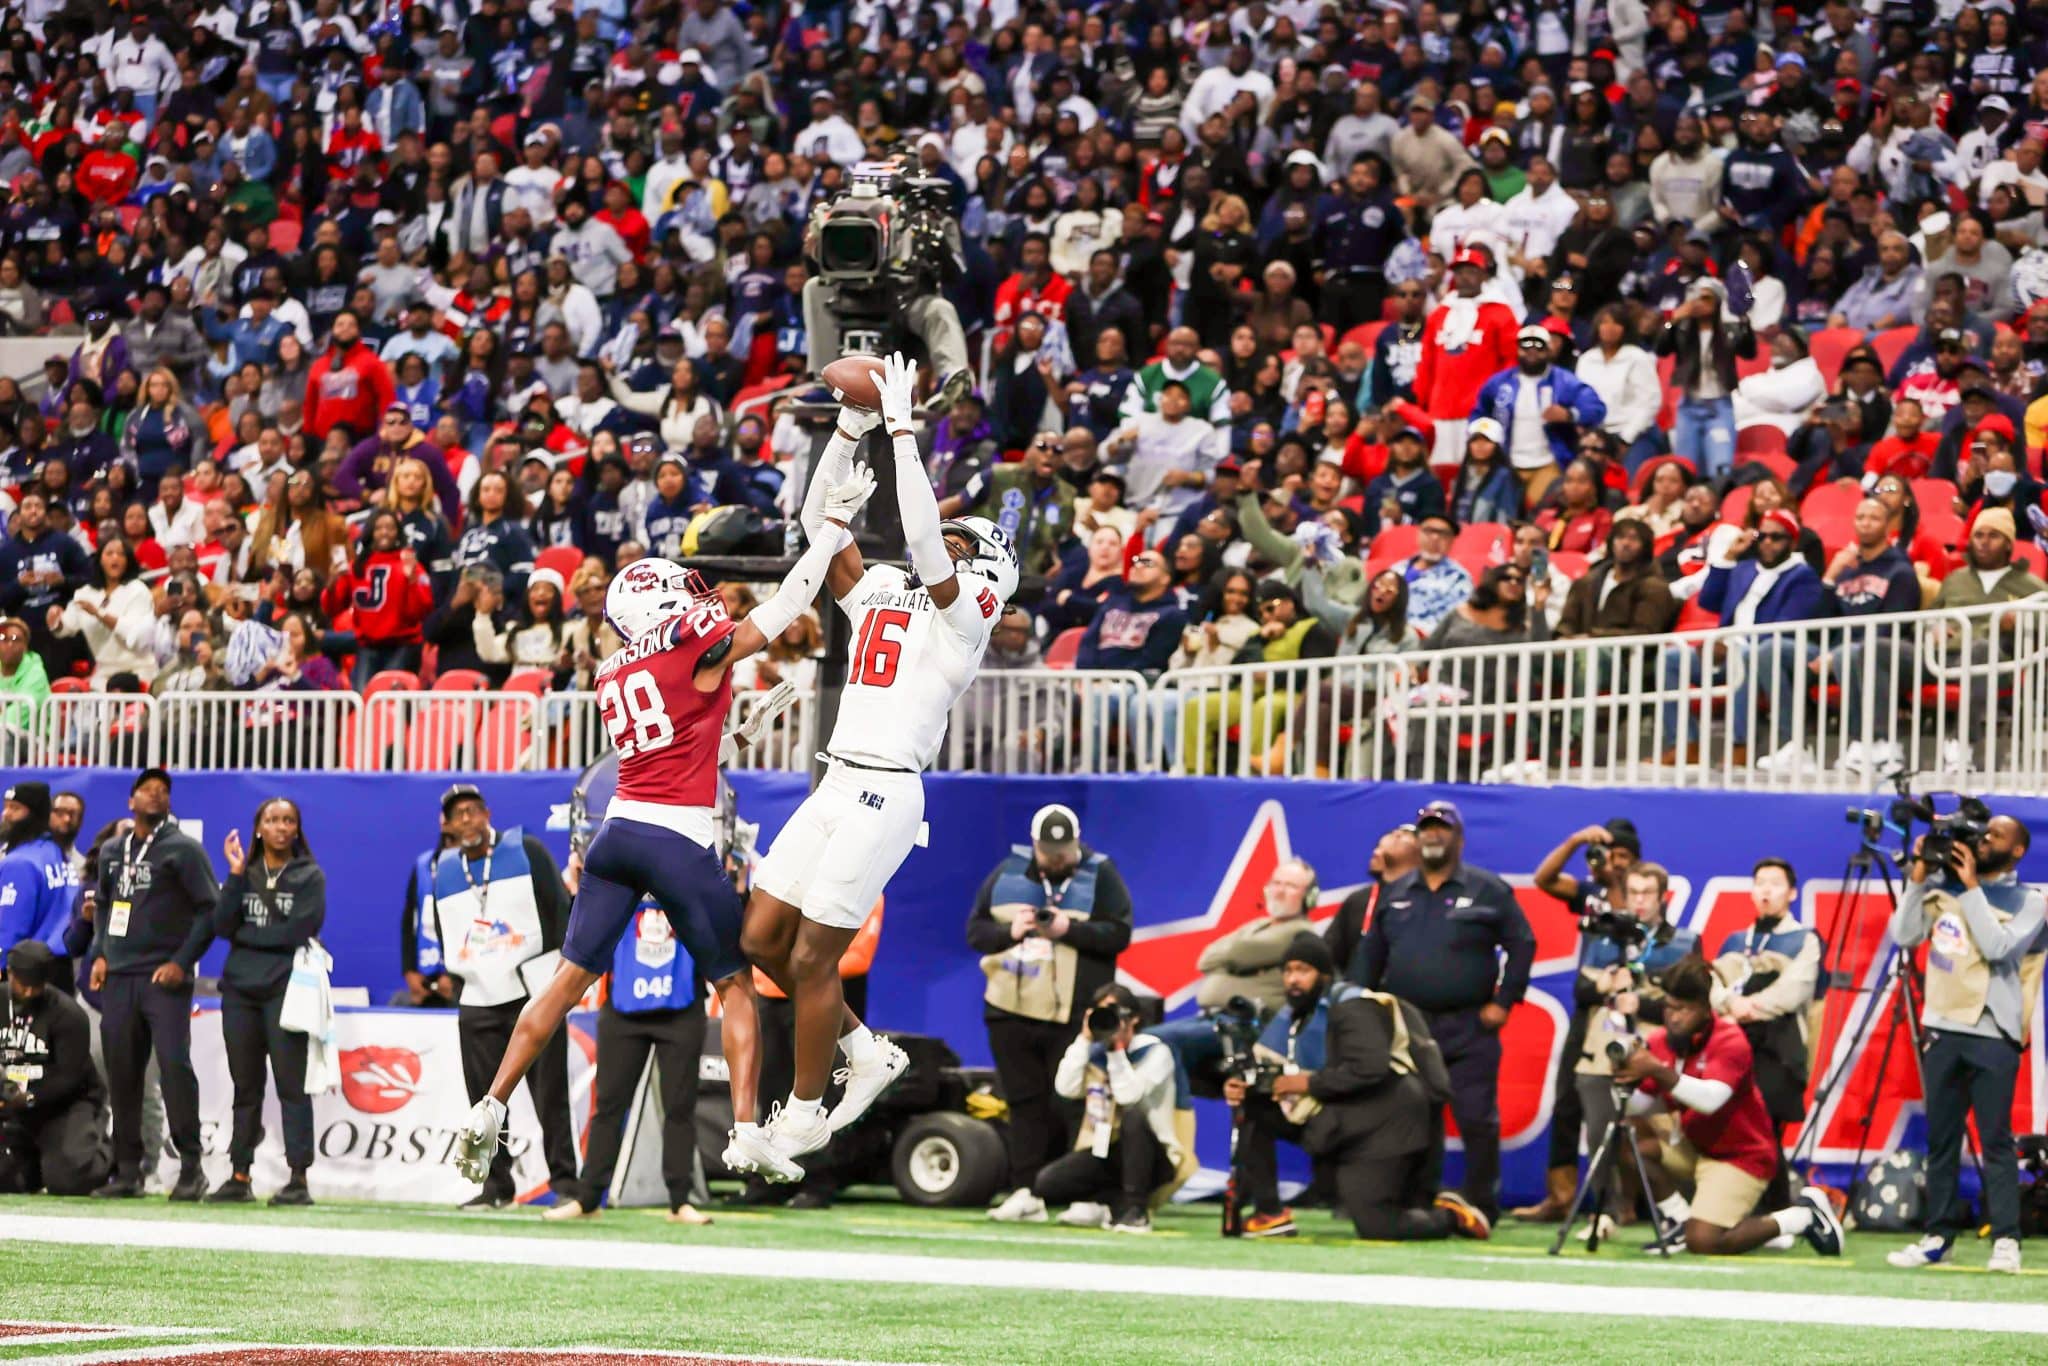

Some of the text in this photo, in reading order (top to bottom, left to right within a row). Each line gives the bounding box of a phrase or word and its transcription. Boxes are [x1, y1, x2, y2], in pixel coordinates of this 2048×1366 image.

[353, 564, 392, 612] J
[975, 586, 999, 619] 16
[686, 597, 729, 638] 28
[849, 607, 912, 688] 16
[600, 669, 675, 759] 28
